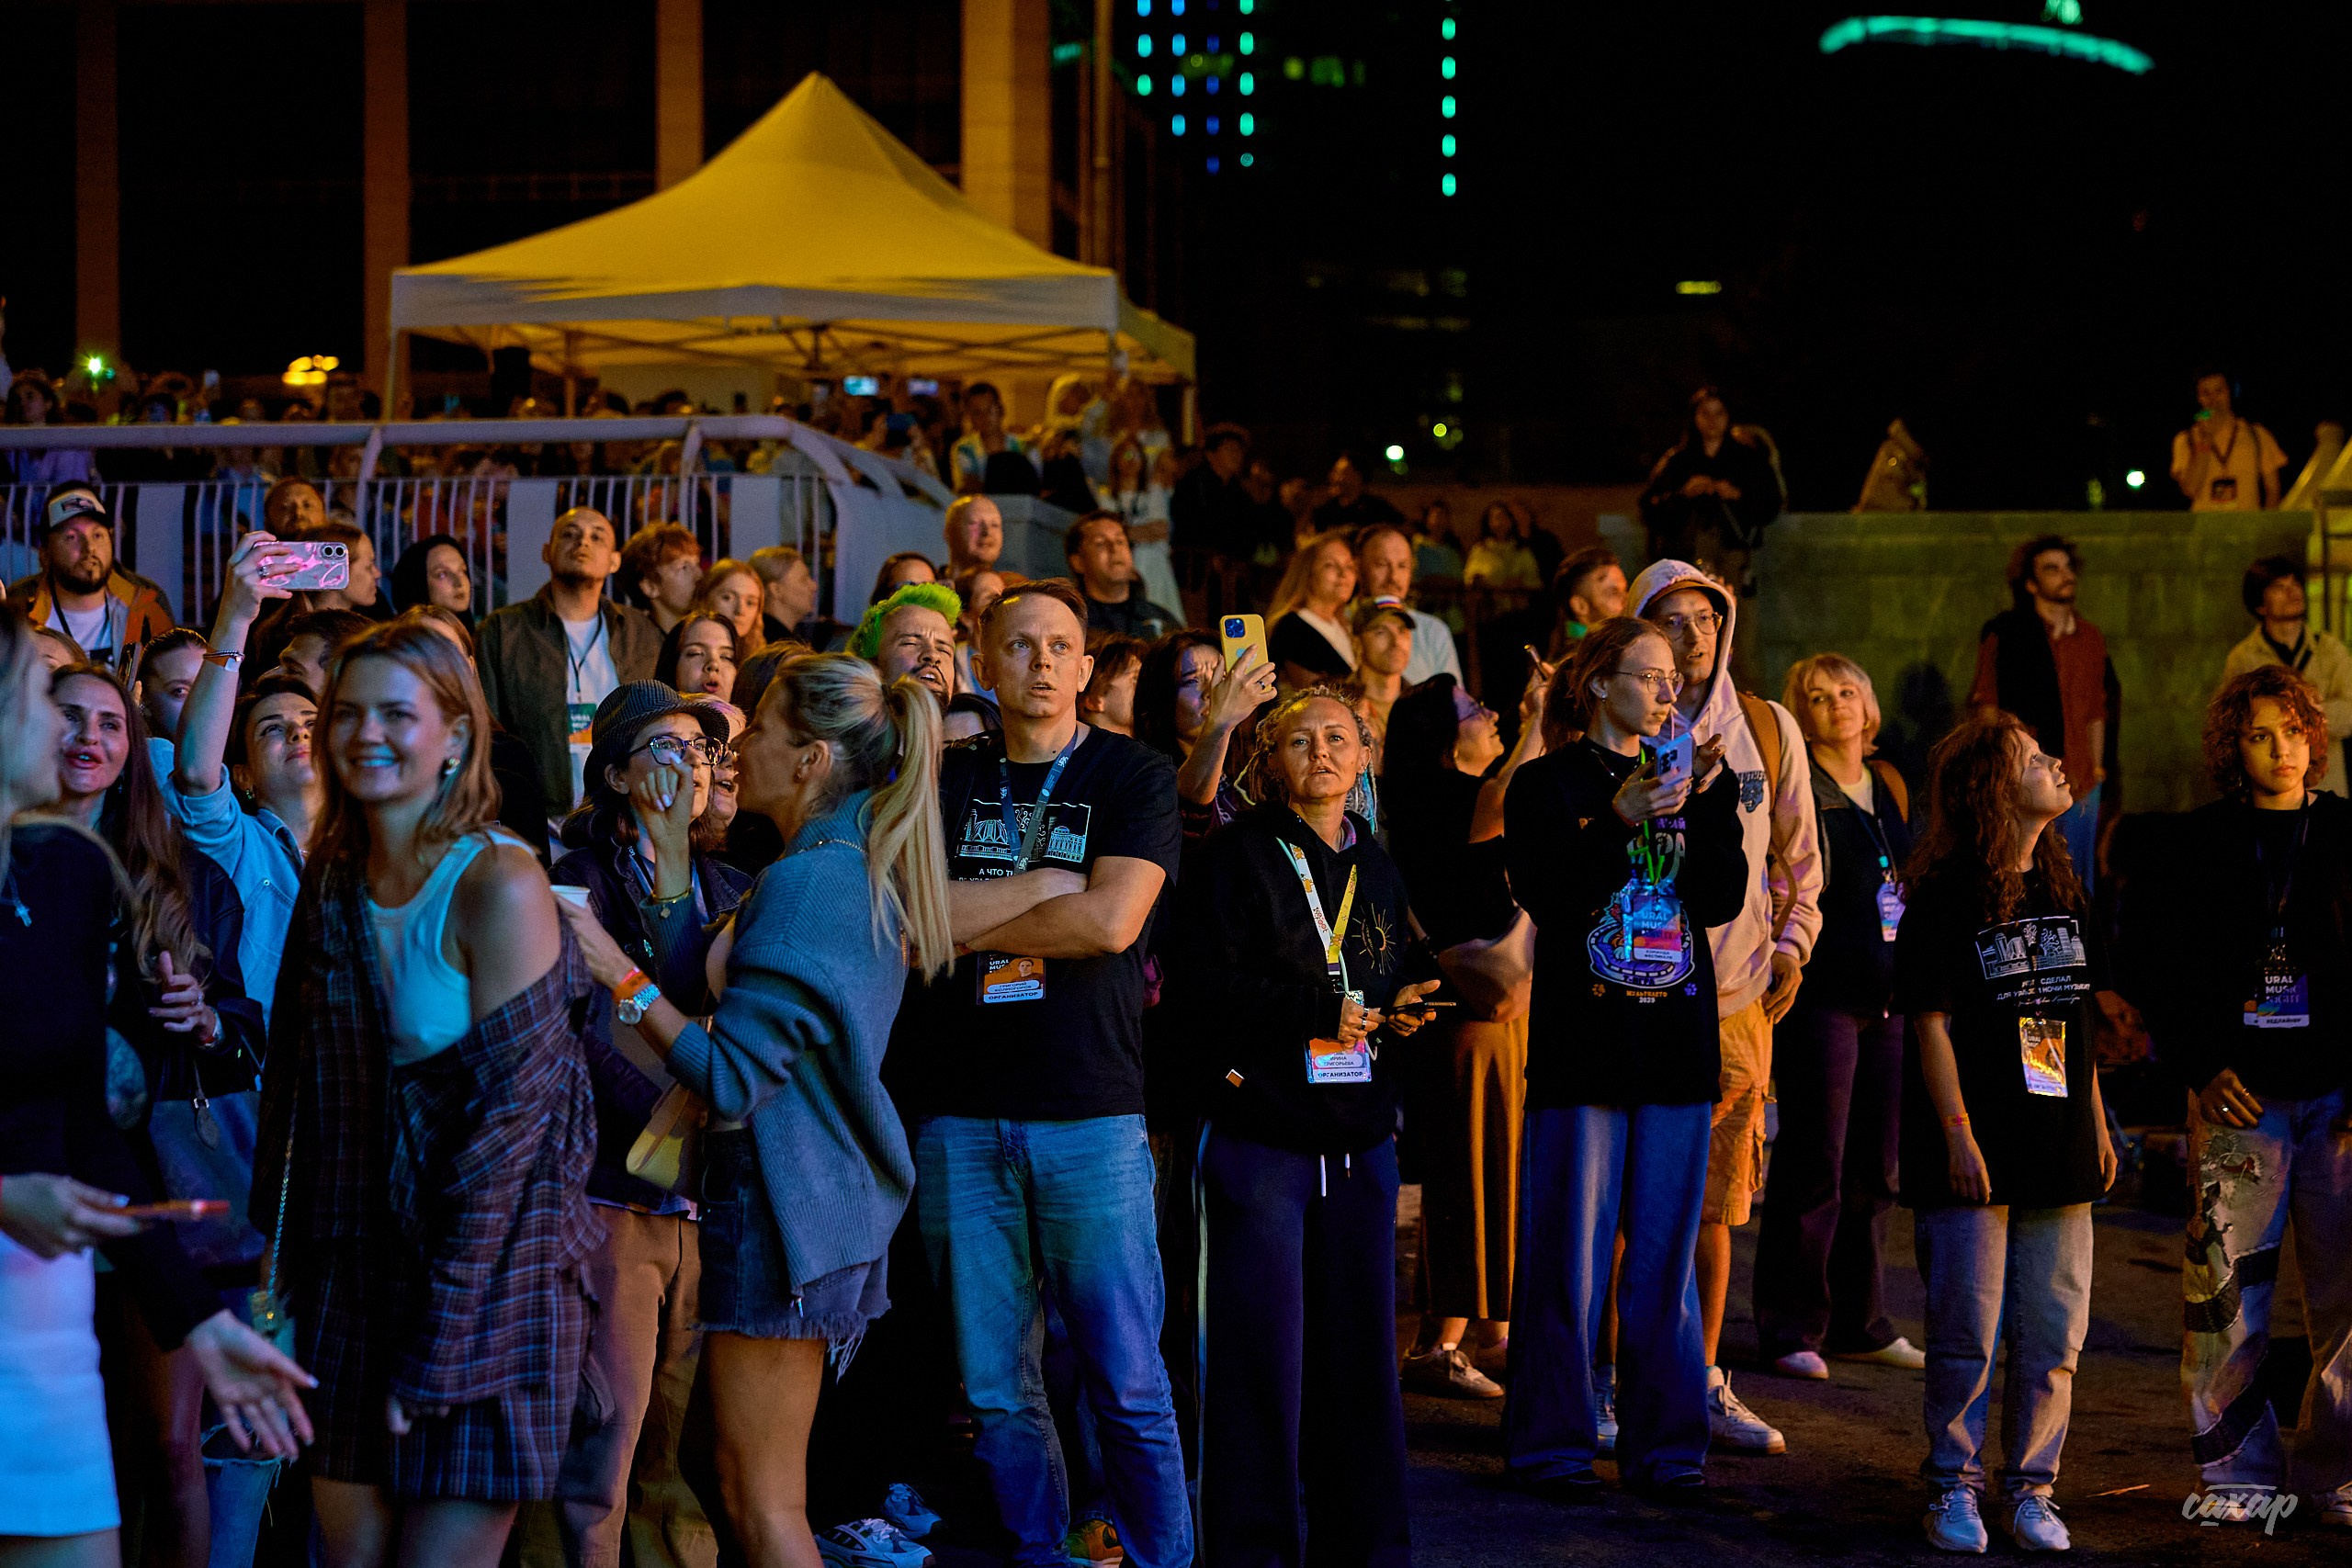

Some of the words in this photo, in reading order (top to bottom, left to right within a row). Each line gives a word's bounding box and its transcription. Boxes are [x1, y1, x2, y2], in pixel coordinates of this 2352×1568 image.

[987, 868, 1004, 876] ЧТО
[2041, 975, 2071, 985] СДЕЛАЛ
[2265, 975, 2293, 984] URAL
[989, 992, 1037, 1000] ОРГАНИЗАТОР
[1996, 992, 2012, 1000] ДЛЯ
[2042, 984, 2063, 994] НОЧИ
